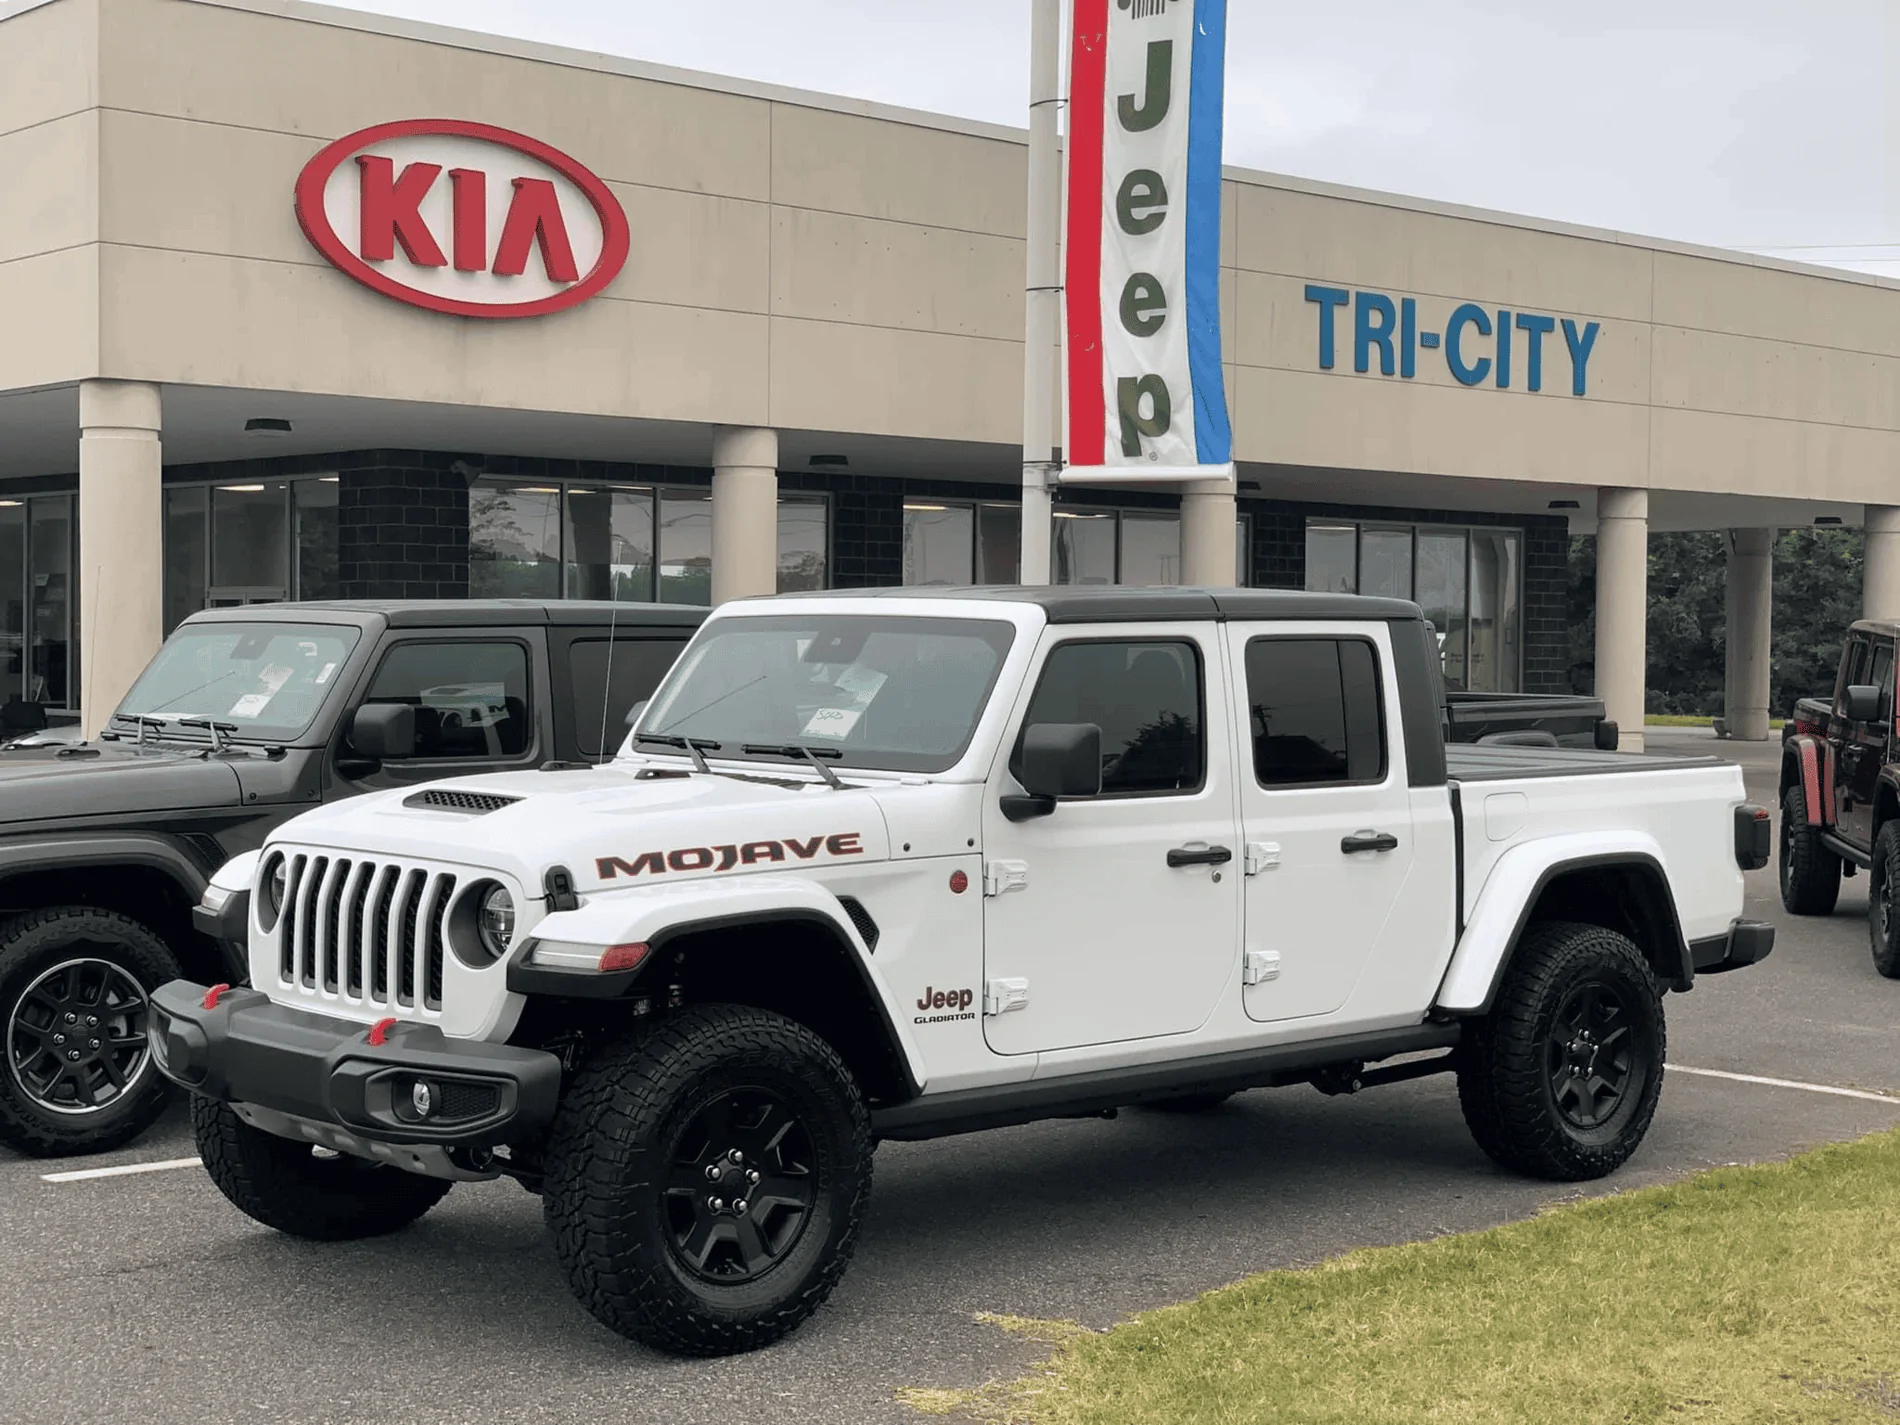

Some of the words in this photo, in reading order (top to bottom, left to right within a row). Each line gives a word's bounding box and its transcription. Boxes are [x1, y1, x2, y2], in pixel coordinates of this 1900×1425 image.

[355, 155, 580, 283] KIA
[1116, 40, 1174, 458] Jeep
[1304, 283, 1601, 397] TRI-CITY
[595, 832, 864, 880] MOJAVE
[914, 1012, 976, 1025] GLADIATOR
[917, 986, 973, 1012] Jeep
